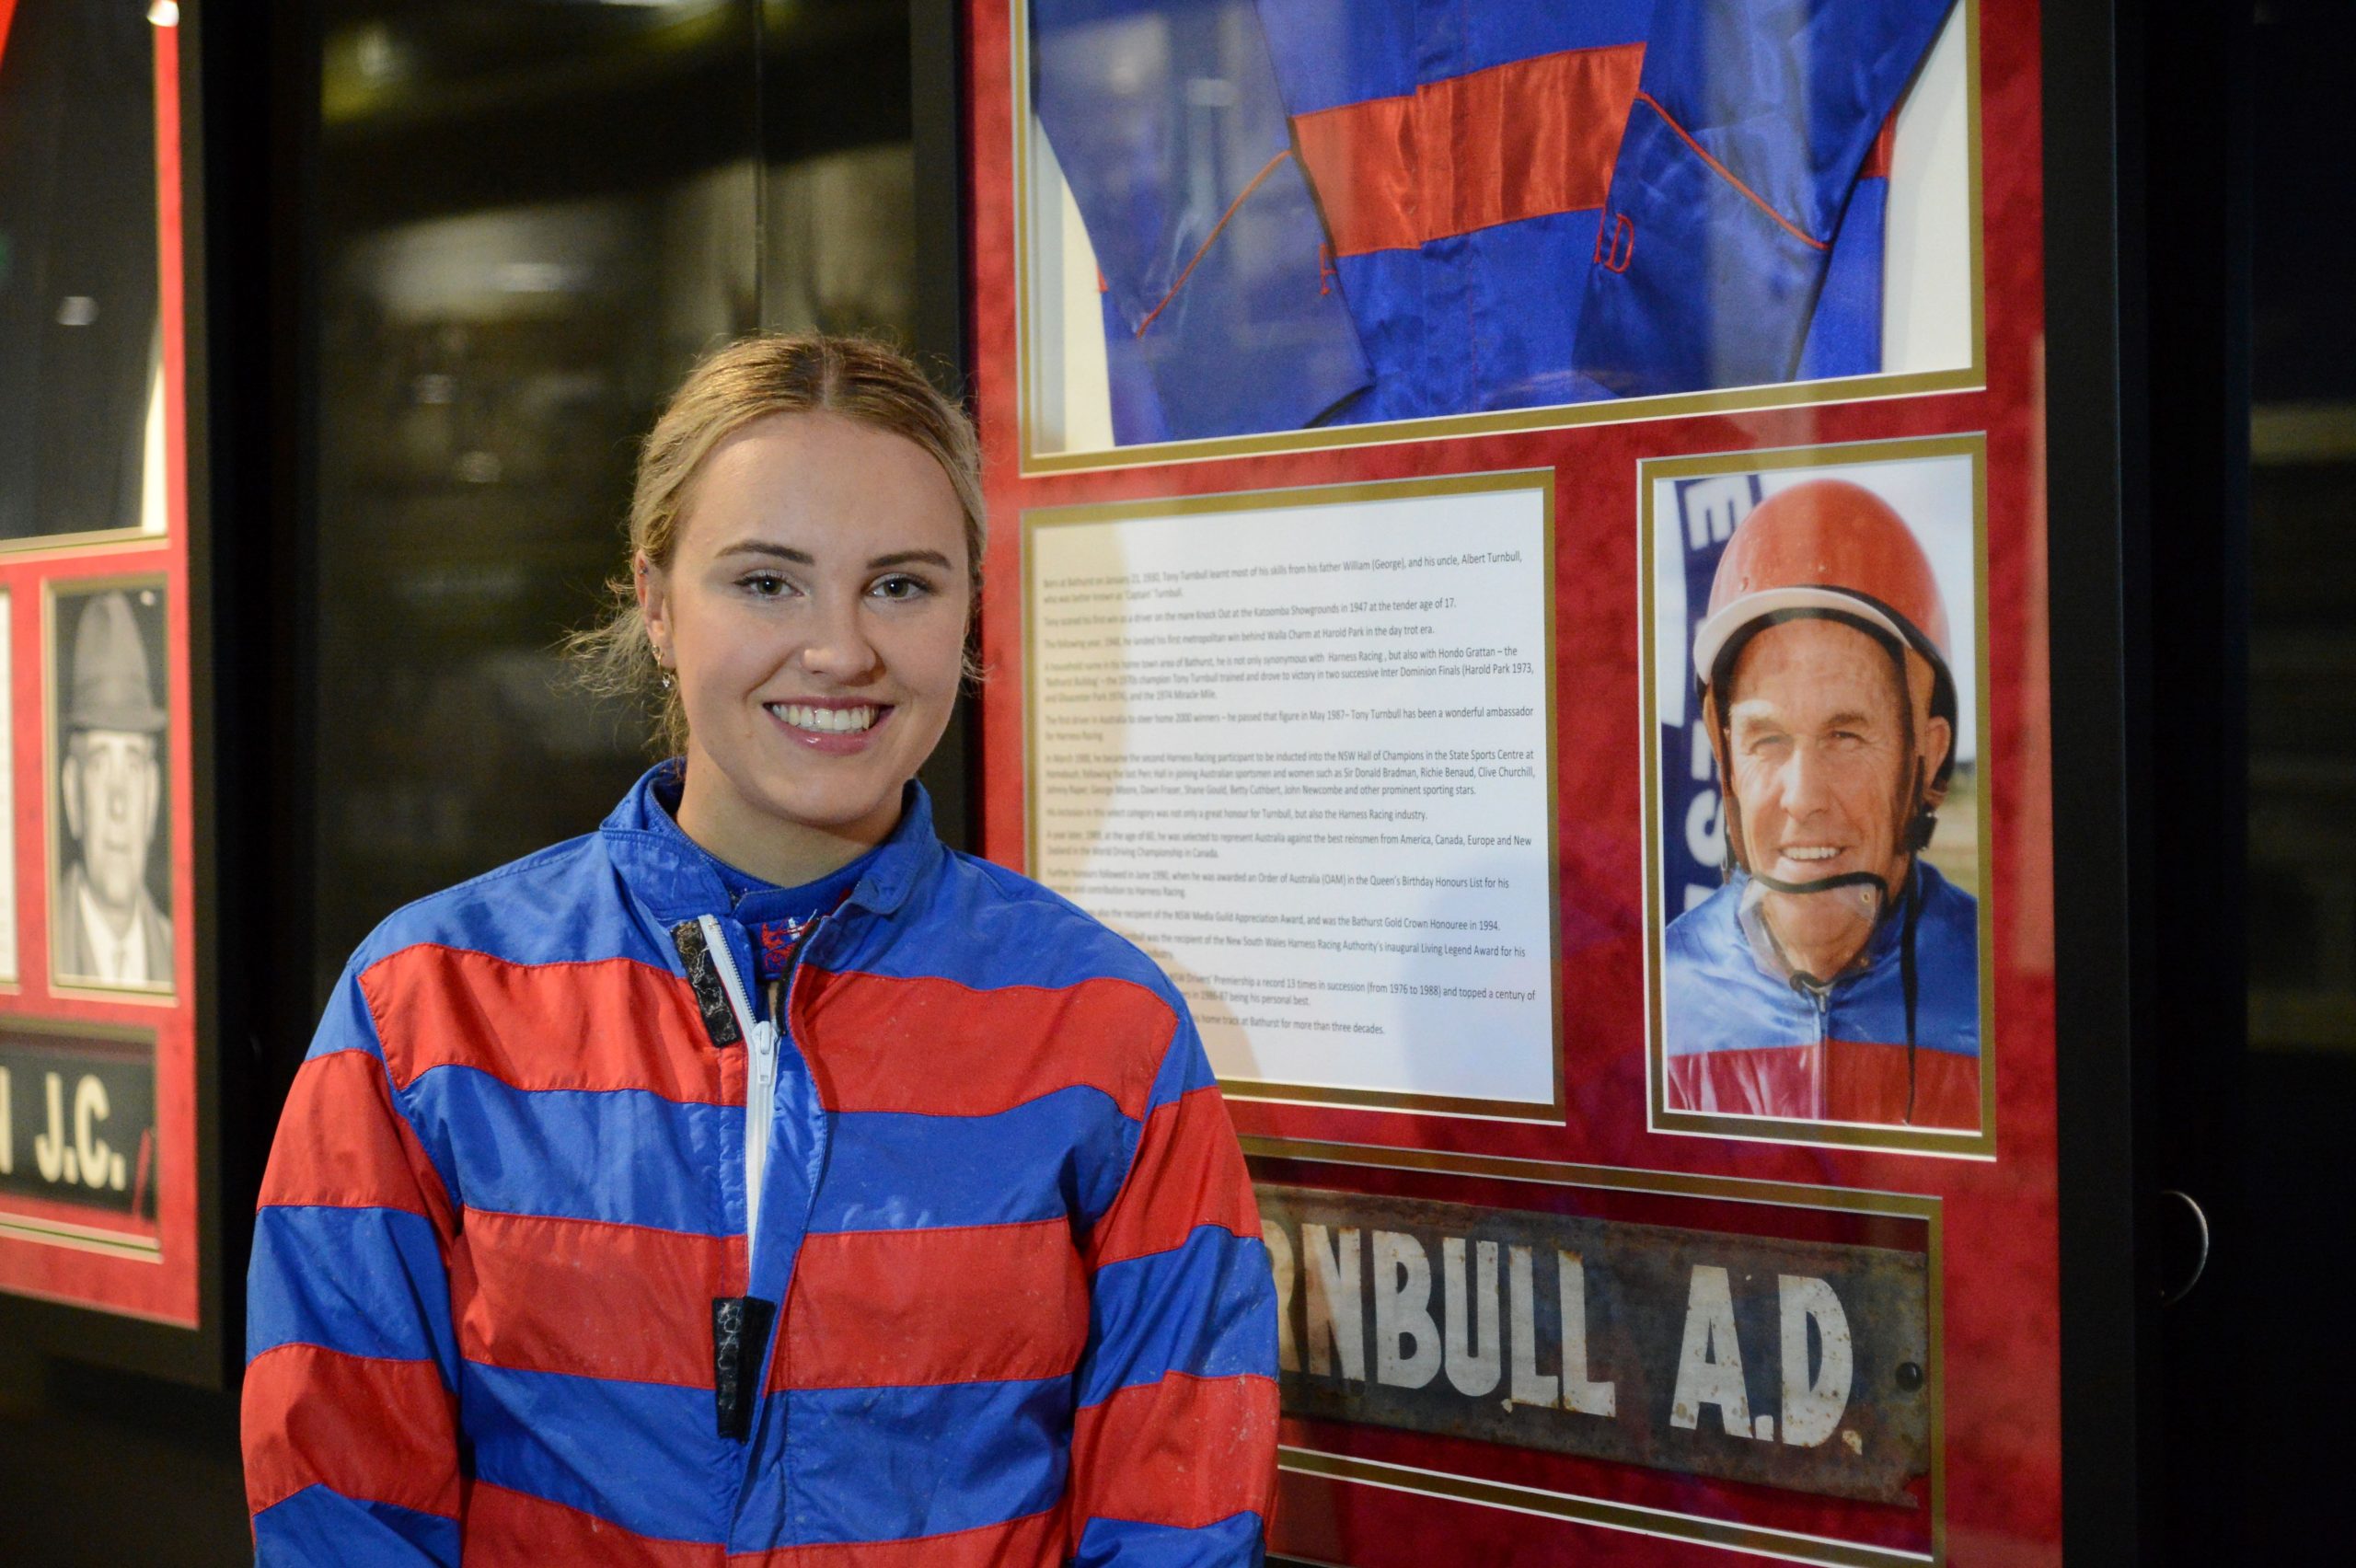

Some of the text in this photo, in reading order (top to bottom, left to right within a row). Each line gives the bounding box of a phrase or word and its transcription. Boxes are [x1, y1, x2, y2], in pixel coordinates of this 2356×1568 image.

[1342, 559, 1370, 571] William
[1407, 556, 1423, 567] and
[1424, 555, 1436, 566] his
[1461, 552, 1485, 564] Albert
[1340, 602, 1347, 613] in
[1349, 601, 1368, 612] 1947
[1369, 601, 1377, 612] at
[1378, 600, 1392, 611] the
[1392, 598, 1418, 610] tender
[1418, 600, 1433, 611] age
[1434, 597, 1443, 608] of
[1347, 626, 1365, 637] Park
[1365, 625, 1373, 636] in
[1374, 625, 1387, 636] the
[1388, 624, 1403, 637] day
[1403, 624, 1418, 635] trot
[1358, 650, 1383, 663] Racing
[1388, 649, 1402, 660] but
[1403, 648, 1418, 660] also
[1419, 648, 1437, 659] with
[1438, 647, 1464, 658] Hondo
[1465, 646, 1495, 657] Grattan
[1503, 645, 1517, 656] the
[1341, 666, 1380, 678] successive
[1380, 666, 1399, 677] Inter
[1400, 664, 1437, 676] Dominion
[1438, 663, 1461, 675] Finals
[1461, 663, 1491, 676] (Harold
[1492, 662, 1510, 674] Park
[1350, 709, 1369, 721] Tony
[1369, 708, 1401, 719] Turnbull
[1402, 708, 1415, 719] has
[1416, 707, 1437, 718] been
[1444, 706, 1484, 718] wonderful
[1485, 705, 1534, 717] ambassador
[1337, 750, 1356, 761] NSW
[1357, 749, 1371, 761] Hall
[1372, 749, 1381, 760] of
[1381, 749, 1424, 762] Champions
[1425, 749, 1433, 760] in
[1434, 749, 1448, 760] the
[1449, 749, 1469, 760] State
[1470, 749, 1496, 762] Sports
[1496, 749, 1524, 759] Centre
[1525, 748, 1534, 759] at
[1343, 767, 1354, 778] Sir
[1355, 767, 1380, 778] Donald
[1420, 766, 1443, 778] Richie
[1477, 766, 1496, 777] Clive
[1344, 783, 1358, 794] and
[1359, 783, 1380, 794] other
[1381, 783, 1421, 796] prominent
[1422, 783, 1454, 797] sporting
[1338, 809, 1368, 819] Harness
[1369, 808, 1393, 822] Racing
[1344, 832, 1379, 844] reinsmen
[1380, 833, 1398, 844] from
[1467, 835, 1496, 847] Europe
[1496, 834, 1511, 846] and
[1513, 835, 1531, 846] New
[1346, 873, 1355, 884] in
[1355, 873, 1369, 885] the
[1402, 874, 1434, 889] Birthday
[1435, 876, 1468, 887] Honours
[1469, 876, 1483, 888] List
[1484, 876, 1496, 888] for
[1497, 876, 1509, 888] his
[1336, 915, 1350, 926] the
[1351, 915, 1383, 927] Bathurst
[1383, 917, 1402, 928] Gold
[1403, 917, 1428, 928] Crown
[1429, 917, 1468, 930] Honouree
[1469, 918, 1477, 930] in
[1384, 940, 1419, 954] inaugural
[1420, 942, 1443, 956] Living
[1444, 943, 1472, 956] Legend
[1472, 944, 1499, 956] Award
[1499, 945, 1512, 956] for
[1513, 945, 1525, 957] his
[1389, 983, 1408, 994] 1976
[1409, 984, 1418, 995] to
[1419, 984, 1441, 997] 1988)
[1442, 986, 1457, 997] and
[1458, 986, 1486, 999] topped
[1495, 988, 1525, 1002] century
[1526, 989, 1536, 1000] of
[34, 1071, 127, 1192] J.C.
[1669, 1264, 1863, 1456] A.D.
